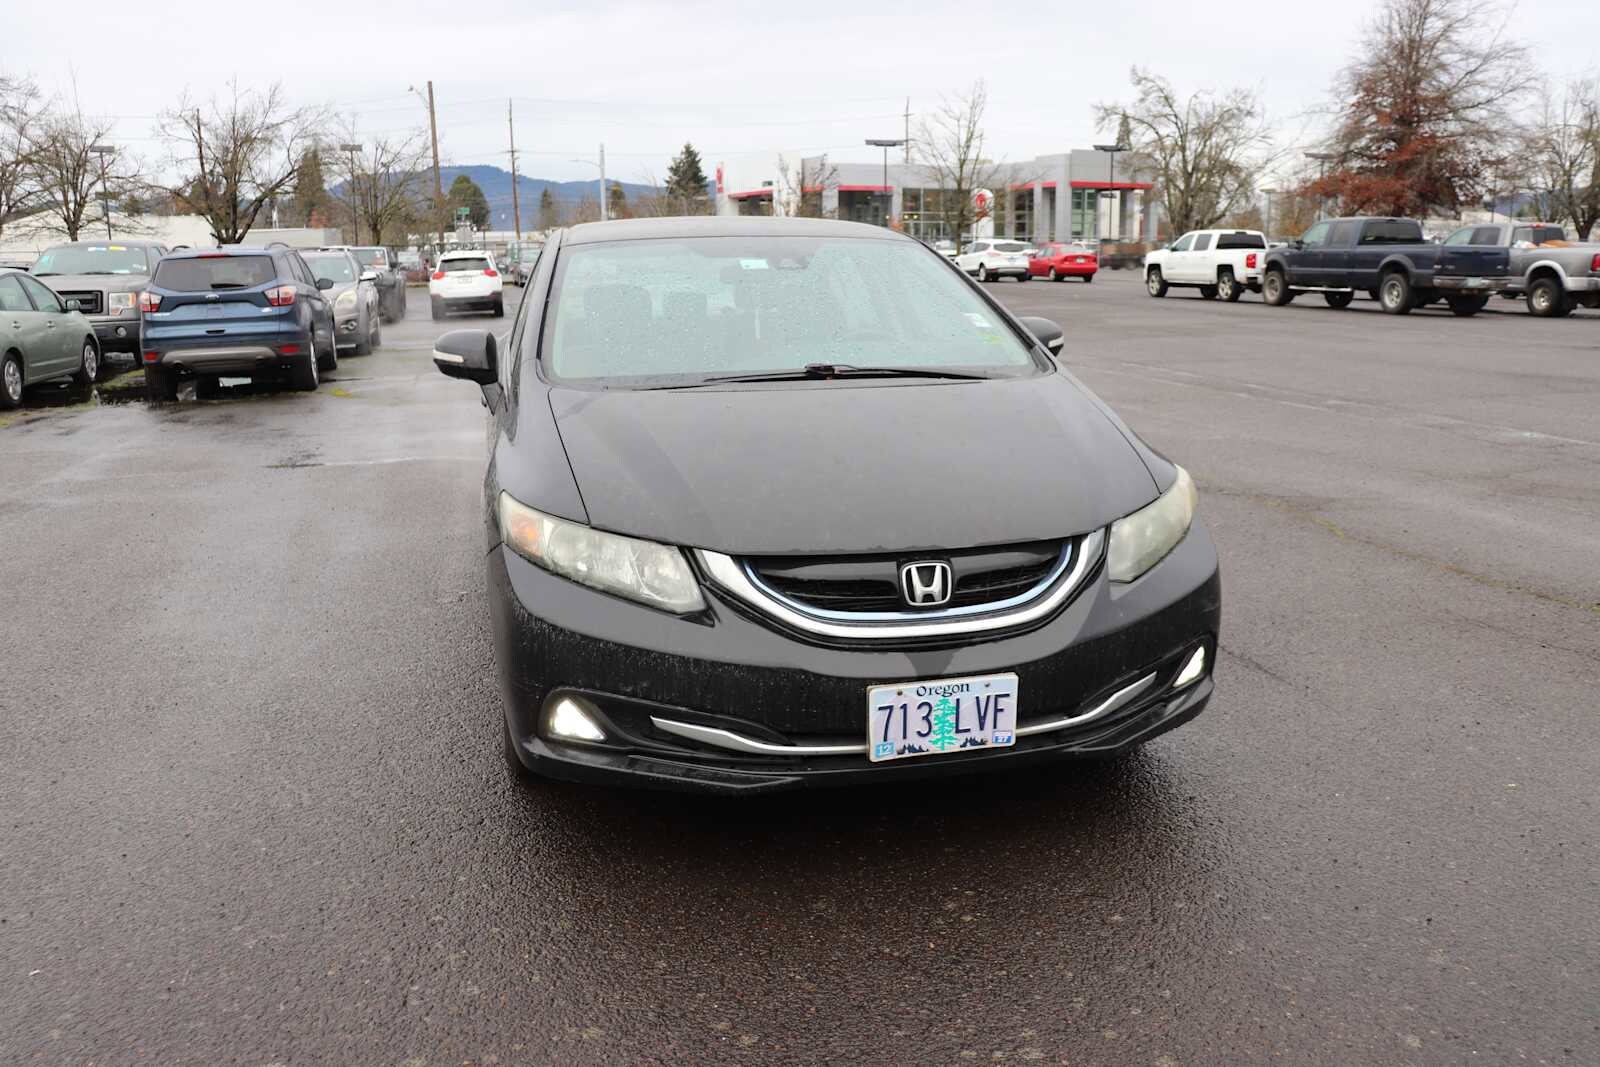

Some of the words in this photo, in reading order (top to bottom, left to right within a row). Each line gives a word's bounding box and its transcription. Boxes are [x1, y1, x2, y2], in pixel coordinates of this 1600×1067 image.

[916, 683, 970, 698] Oregon
[878, 701, 933, 742] 713
[955, 693, 1011, 734] LVF
